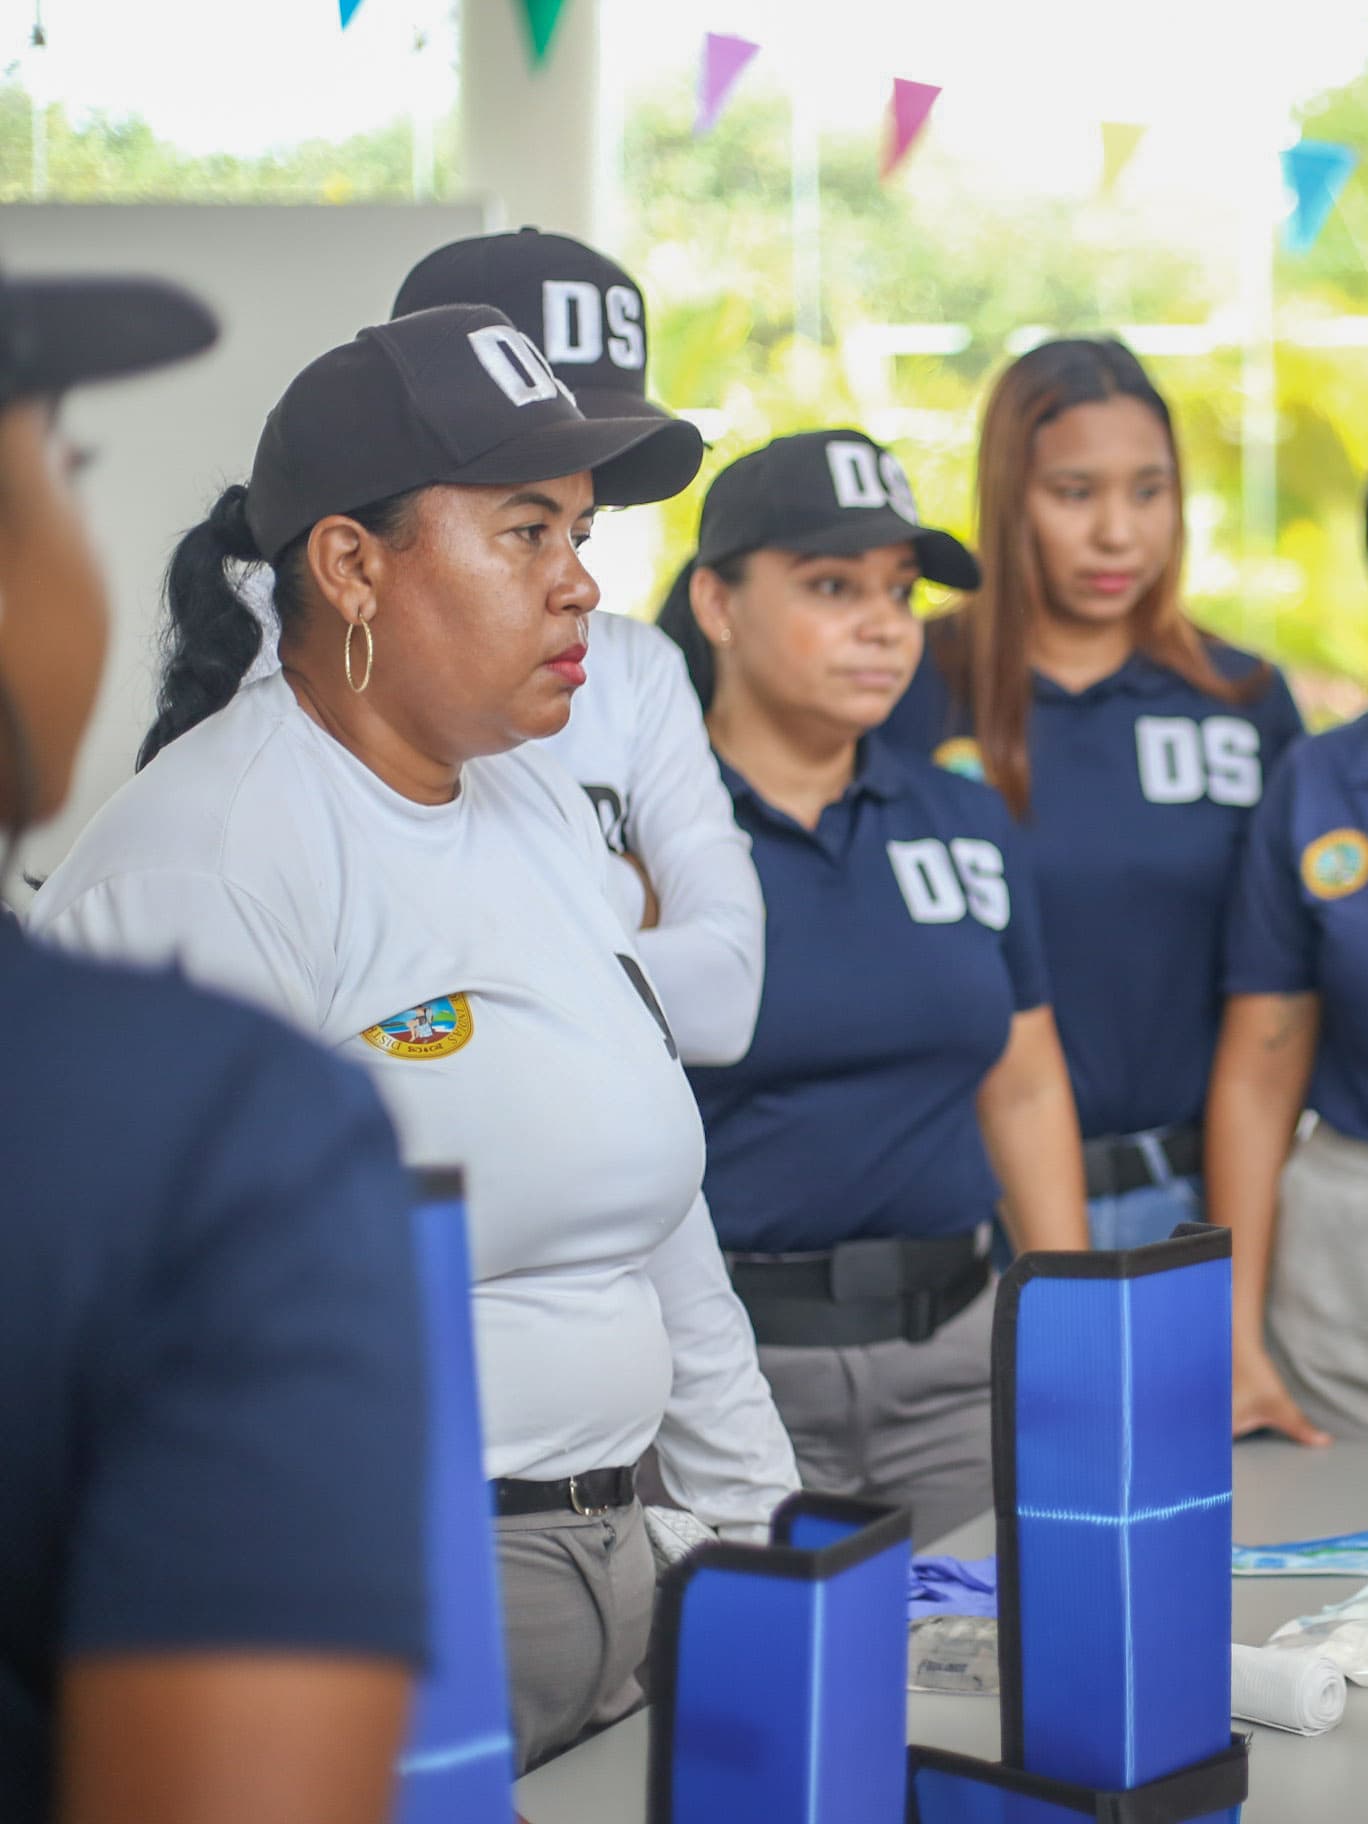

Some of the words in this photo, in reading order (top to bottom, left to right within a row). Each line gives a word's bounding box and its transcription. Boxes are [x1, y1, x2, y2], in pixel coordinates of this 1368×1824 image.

[468, 324, 576, 408] D
[542, 279, 646, 370] DS
[825, 440, 918, 526] DS
[1135, 715, 1262, 808] DS
[886, 837, 1011, 931] DS
